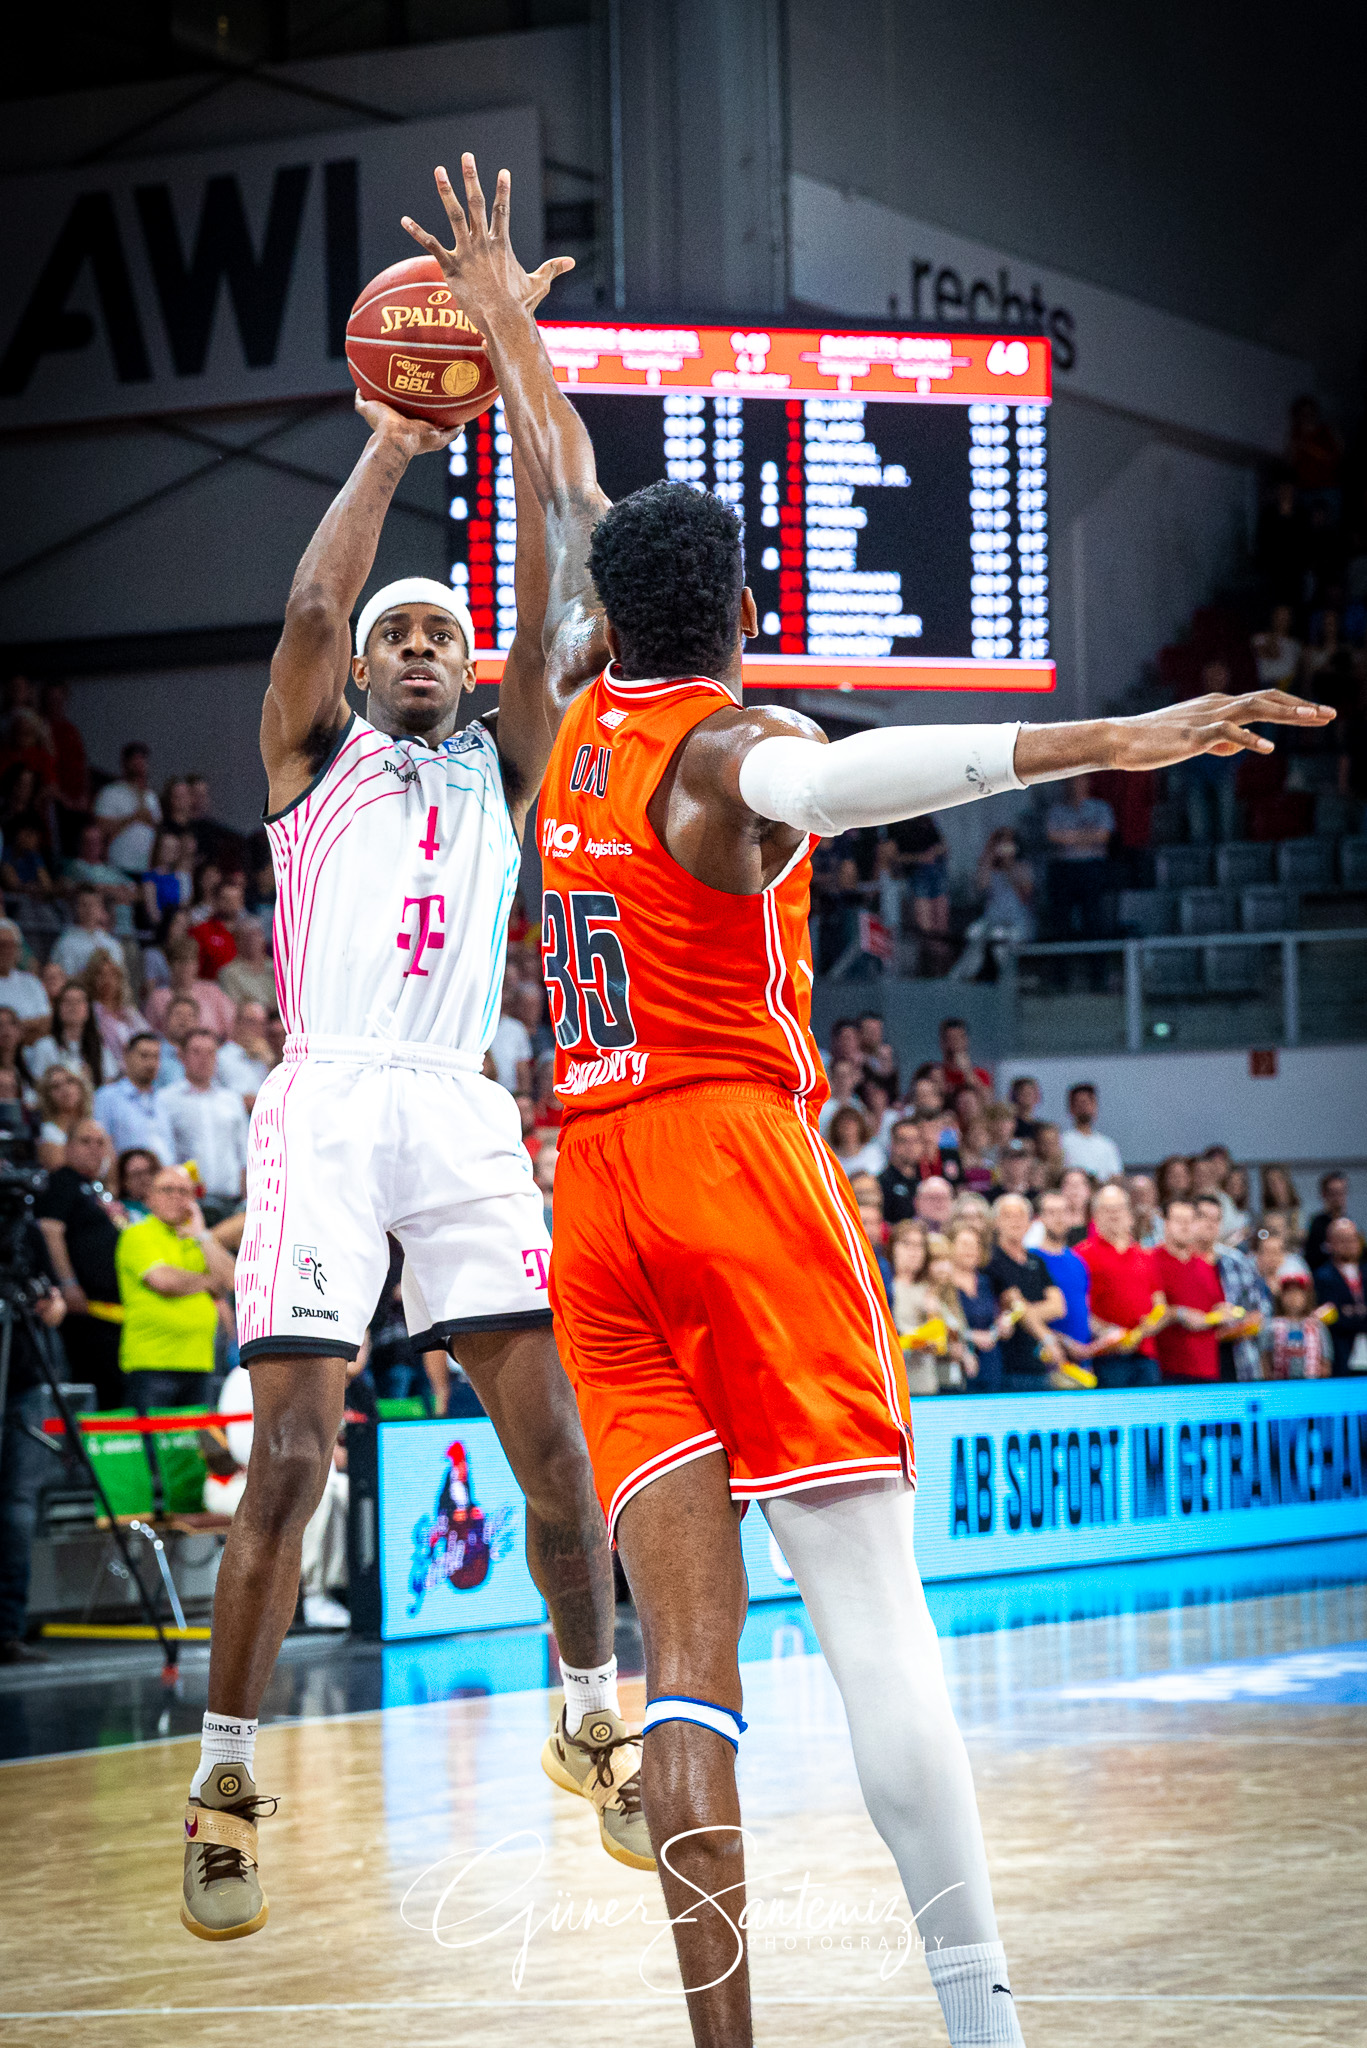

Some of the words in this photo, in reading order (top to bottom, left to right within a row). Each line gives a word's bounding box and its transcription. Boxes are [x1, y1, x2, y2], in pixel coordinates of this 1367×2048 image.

[0, 157, 358, 397] AWI
[394, 375, 433, 393] BBL
[584, 837, 633, 859] logistics
[542, 889, 637, 1050] 35
[292, 1306, 339, 1321] SPALDING
